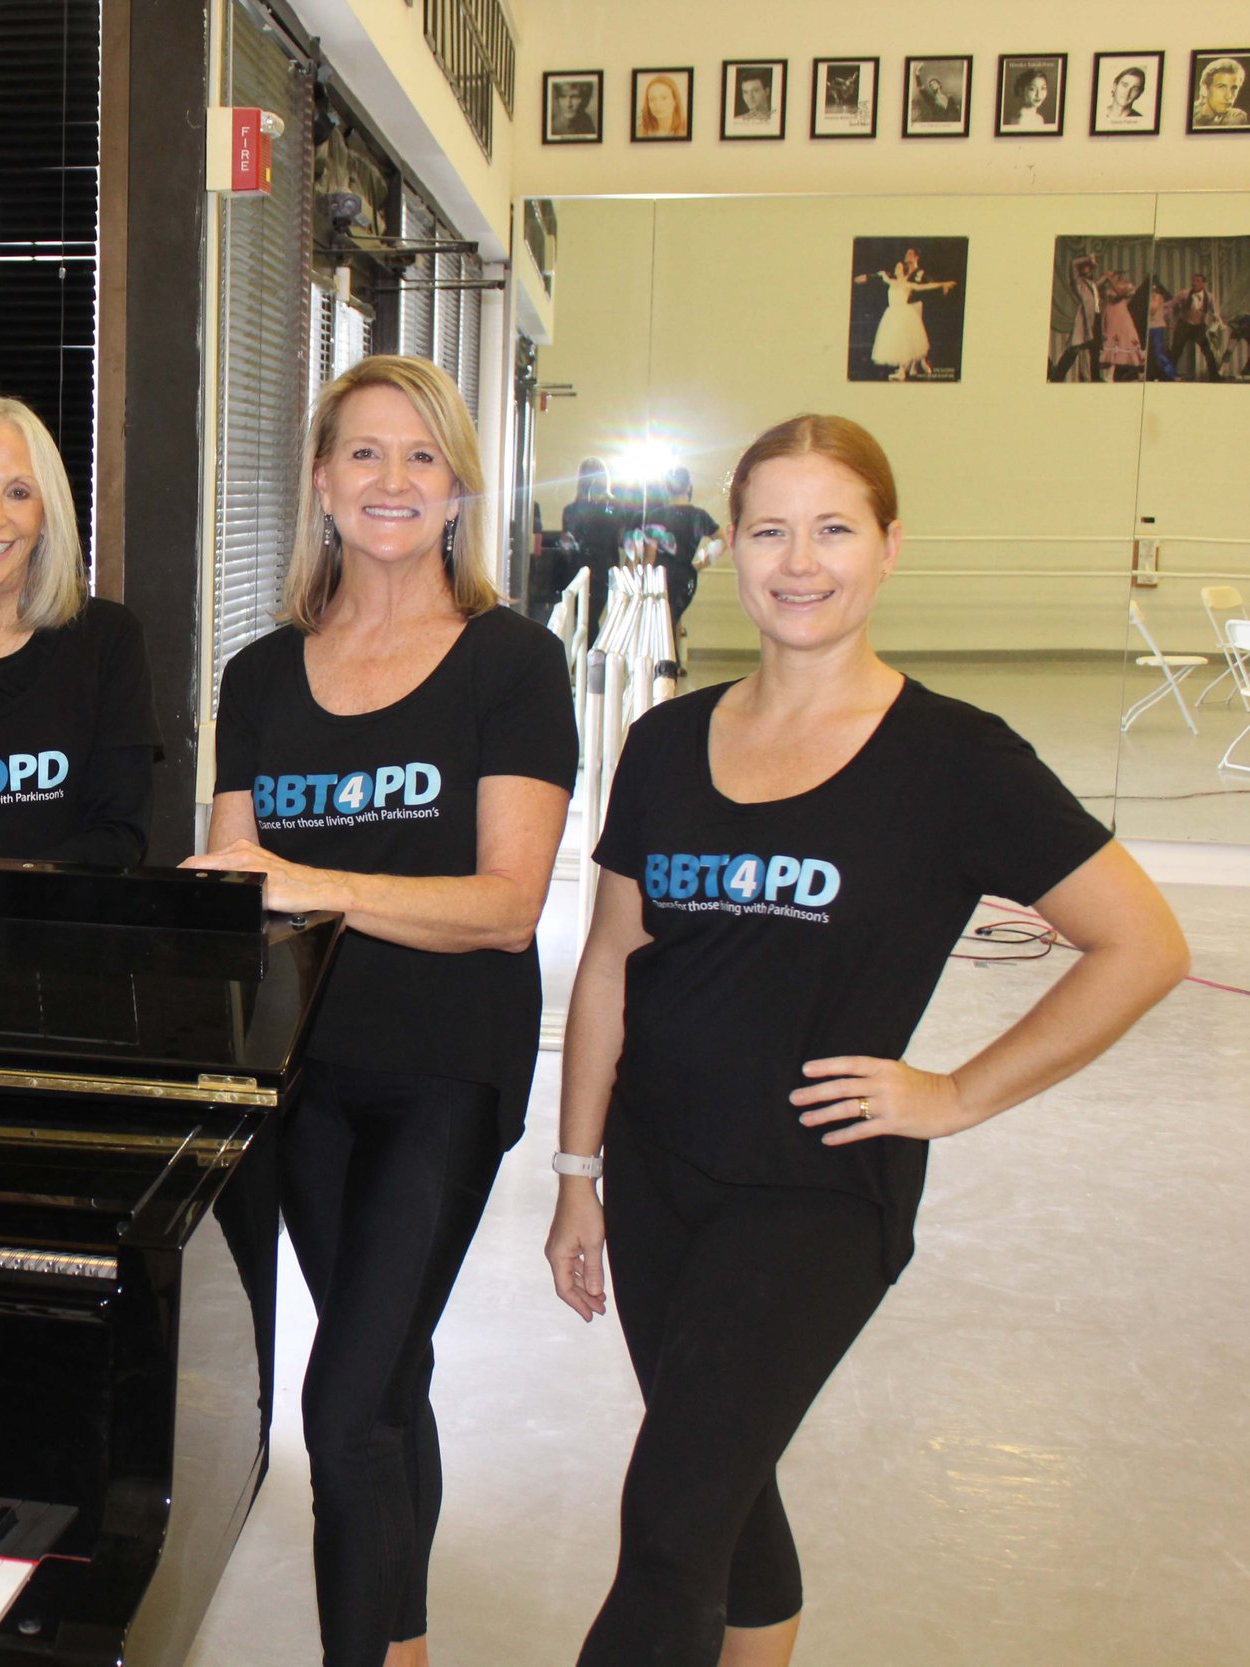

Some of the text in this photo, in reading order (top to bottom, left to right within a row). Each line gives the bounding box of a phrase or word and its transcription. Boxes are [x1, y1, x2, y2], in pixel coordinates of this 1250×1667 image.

[240, 126, 251, 172] FIRE
[15, 788, 64, 803] Parkinson's
[253, 762, 441, 818] BBT4PD
[282, 819, 296, 829] for
[297, 817, 325, 828] those
[325, 815, 354, 827] living
[355, 810, 379, 823] with
[380, 807, 440, 820] Parkinson's
[645, 853, 841, 907] BBT4PD
[687, 900, 720, 912] those
[742, 902, 768, 914] with
[767, 903, 830, 924] Parkinson's
